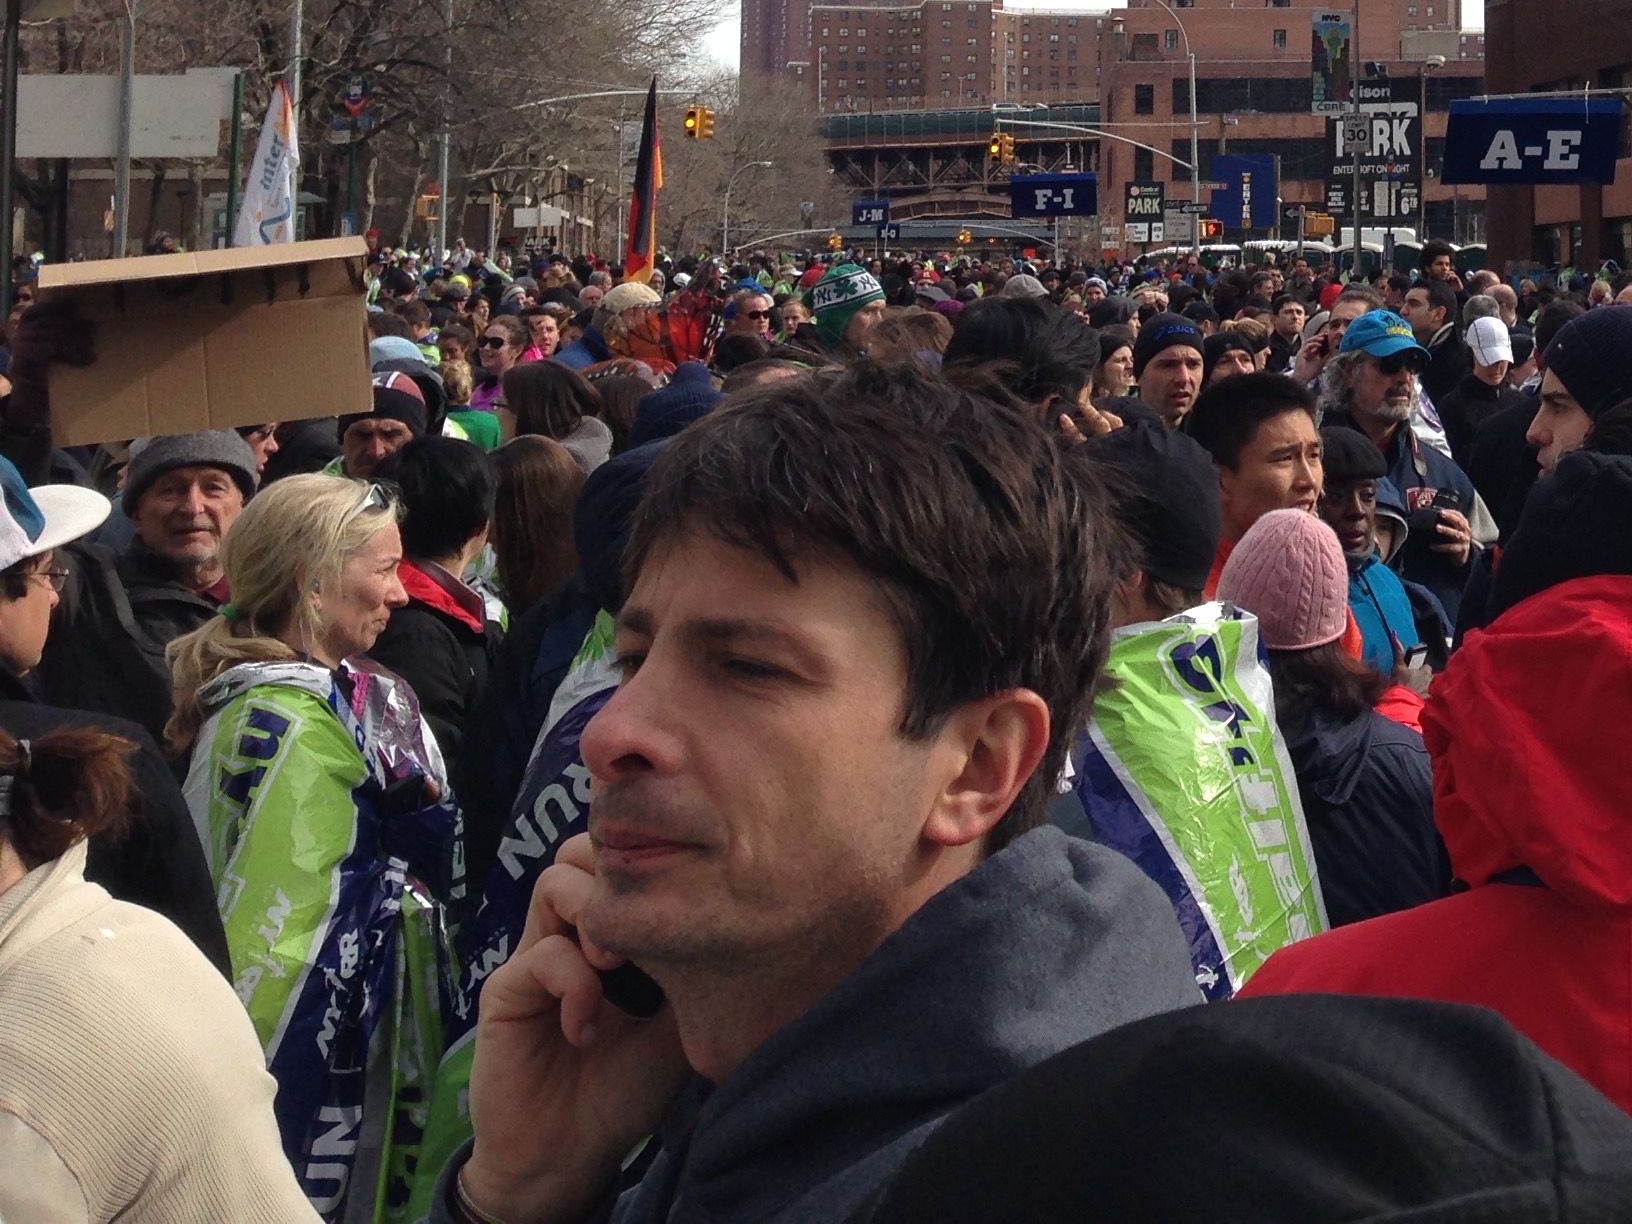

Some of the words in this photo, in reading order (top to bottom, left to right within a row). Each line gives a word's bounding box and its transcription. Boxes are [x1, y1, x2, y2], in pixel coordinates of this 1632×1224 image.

[1347, 129, 1367, 142] 30
[1479, 130, 1582, 170] A-E
[1333, 165, 1354, 175] ENTE
[1034, 188, 1075, 210] F-I
[1128, 197, 1161, 214] PARK
[859, 209, 884, 222] J-M
[304, 1104, 363, 1218] UN
